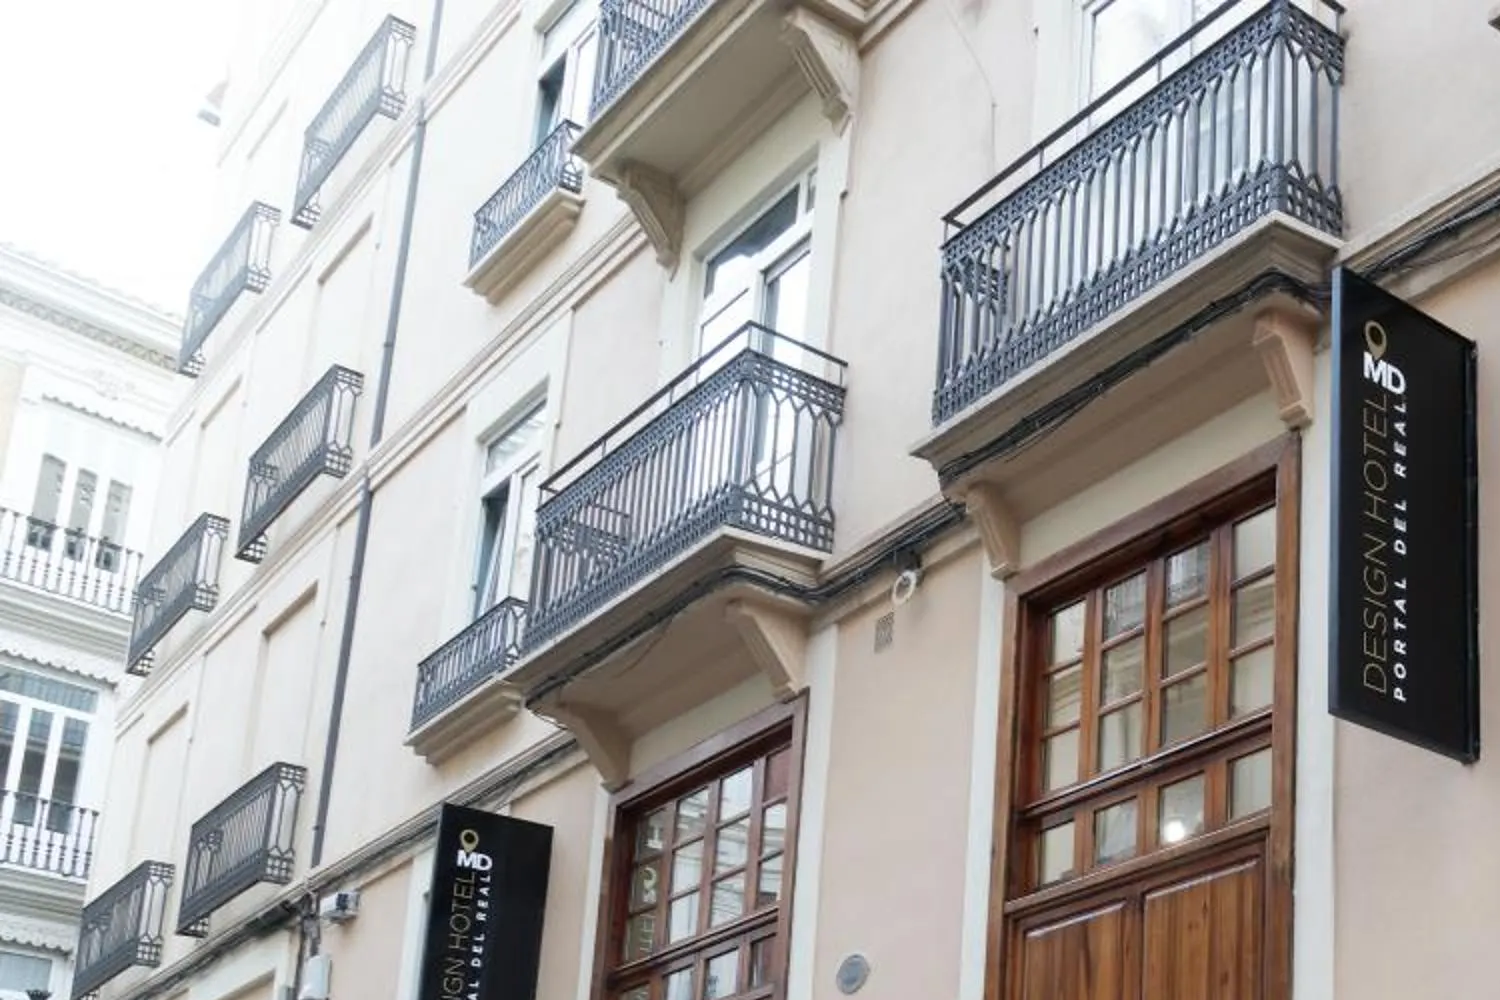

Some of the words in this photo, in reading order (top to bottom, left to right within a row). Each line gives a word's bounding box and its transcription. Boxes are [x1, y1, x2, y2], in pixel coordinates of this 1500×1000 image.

[1363, 350, 1407, 396] MD
[1363, 393, 1388, 525] HOTEL
[1393, 398, 1407, 478] REAL
[1393, 499, 1407, 556] DEL
[1363, 533, 1388, 695] DESIGN
[1393, 577, 1407, 702] PORTAL
[456, 849, 493, 872] MD
[448, 871, 476, 951] HOTEL
[475, 874, 492, 922] REAL
[471, 932, 486, 968] DEL
